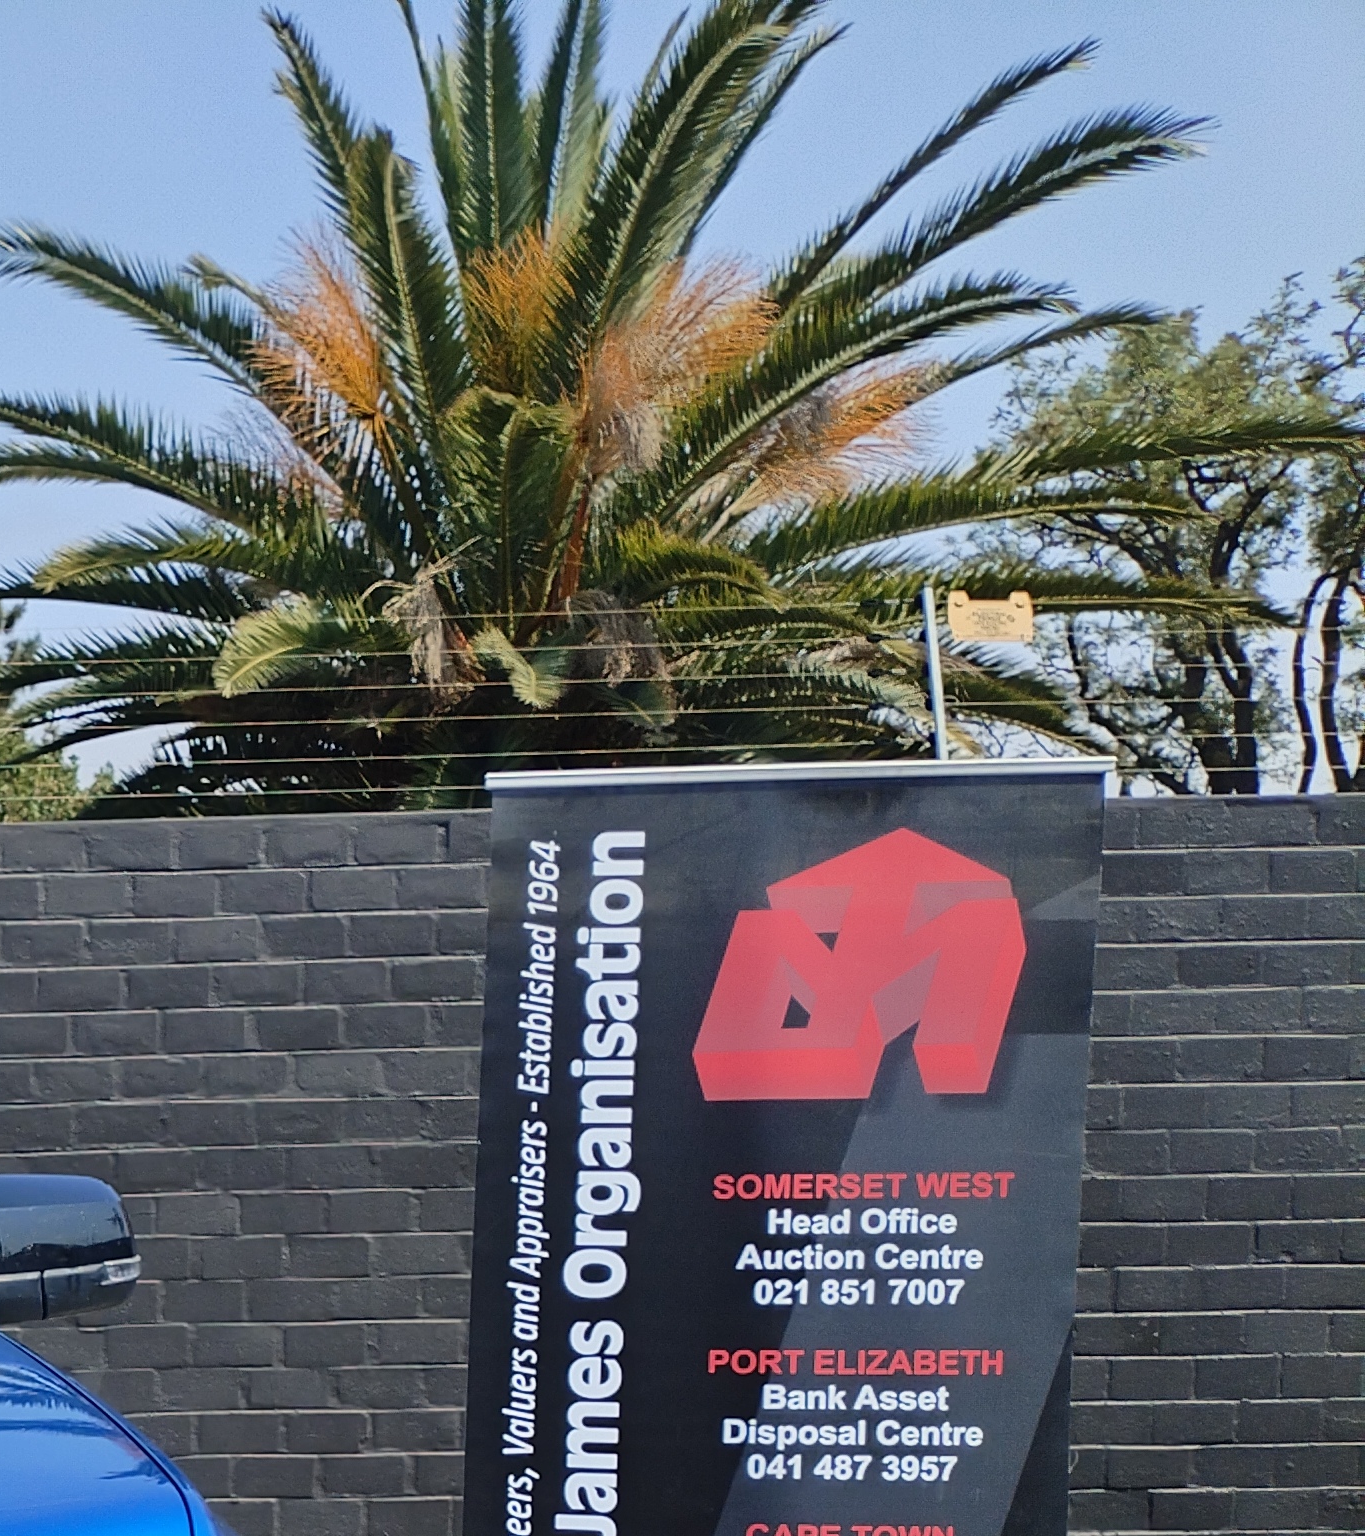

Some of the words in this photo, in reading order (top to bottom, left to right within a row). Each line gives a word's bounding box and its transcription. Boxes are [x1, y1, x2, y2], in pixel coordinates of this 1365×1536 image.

[527, 840, 561, 915] 1964
[517, 922, 557, 1094] Established
[563, 830, 646, 1299] Organisation
[509, 1119, 550, 1278] Appraisers
[713, 1173, 906, 1200] SOMERSET
[916, 1172, 1015, 1198] WEST
[768, 1208, 851, 1235] Head
[860, 1207, 958, 1235] Office
[735, 1243, 865, 1270] Auction
[875, 1243, 984, 1270] Centre
[754, 1278, 809, 1305] 021
[820, 1278, 875, 1306] 851
[887, 1278, 966, 1306] 7007
[506, 1281, 540, 1341] and
[708, 1349, 804, 1374] PORT
[814, 1349, 1004, 1376] ELIZABETH
[501, 1347, 538, 1455] Valuers
[763, 1384, 847, 1411] Bank
[853, 1384, 950, 1412] Asset
[723, 1418, 867, 1451] Disposal
[876, 1419, 984, 1447] Centre
[747, 1453, 802, 1480] 041
[813, 1454, 873, 1481] 487
[881, 1454, 958, 1482] 3957
